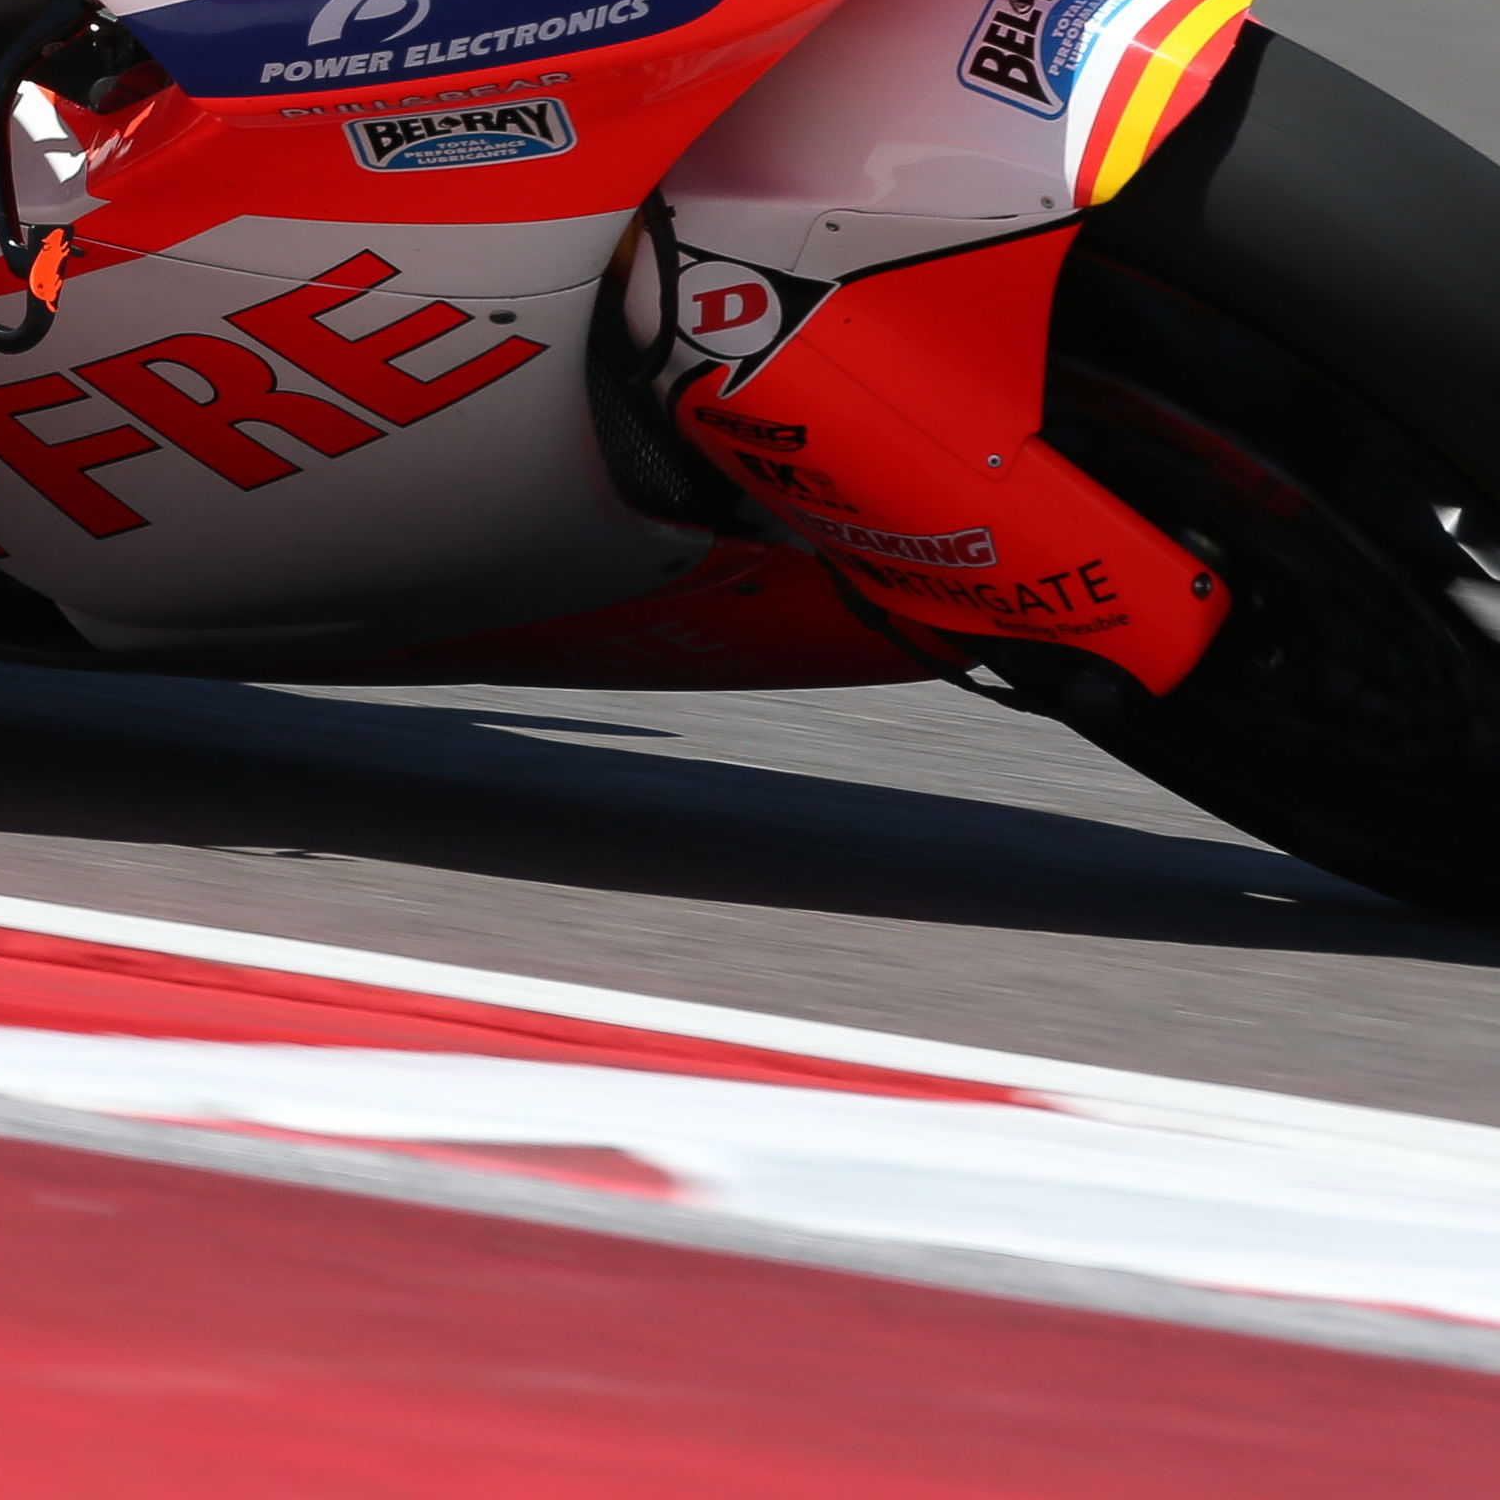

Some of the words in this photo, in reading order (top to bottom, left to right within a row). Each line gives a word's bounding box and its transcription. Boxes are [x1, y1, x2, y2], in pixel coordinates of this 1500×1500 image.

[260, 50, 393, 84] POWER
[404, 140, 526, 159] PERFORMANCE
[436, 139, 489, 149] TOTAL
[417, 149, 518, 165] LUBRICANTS
